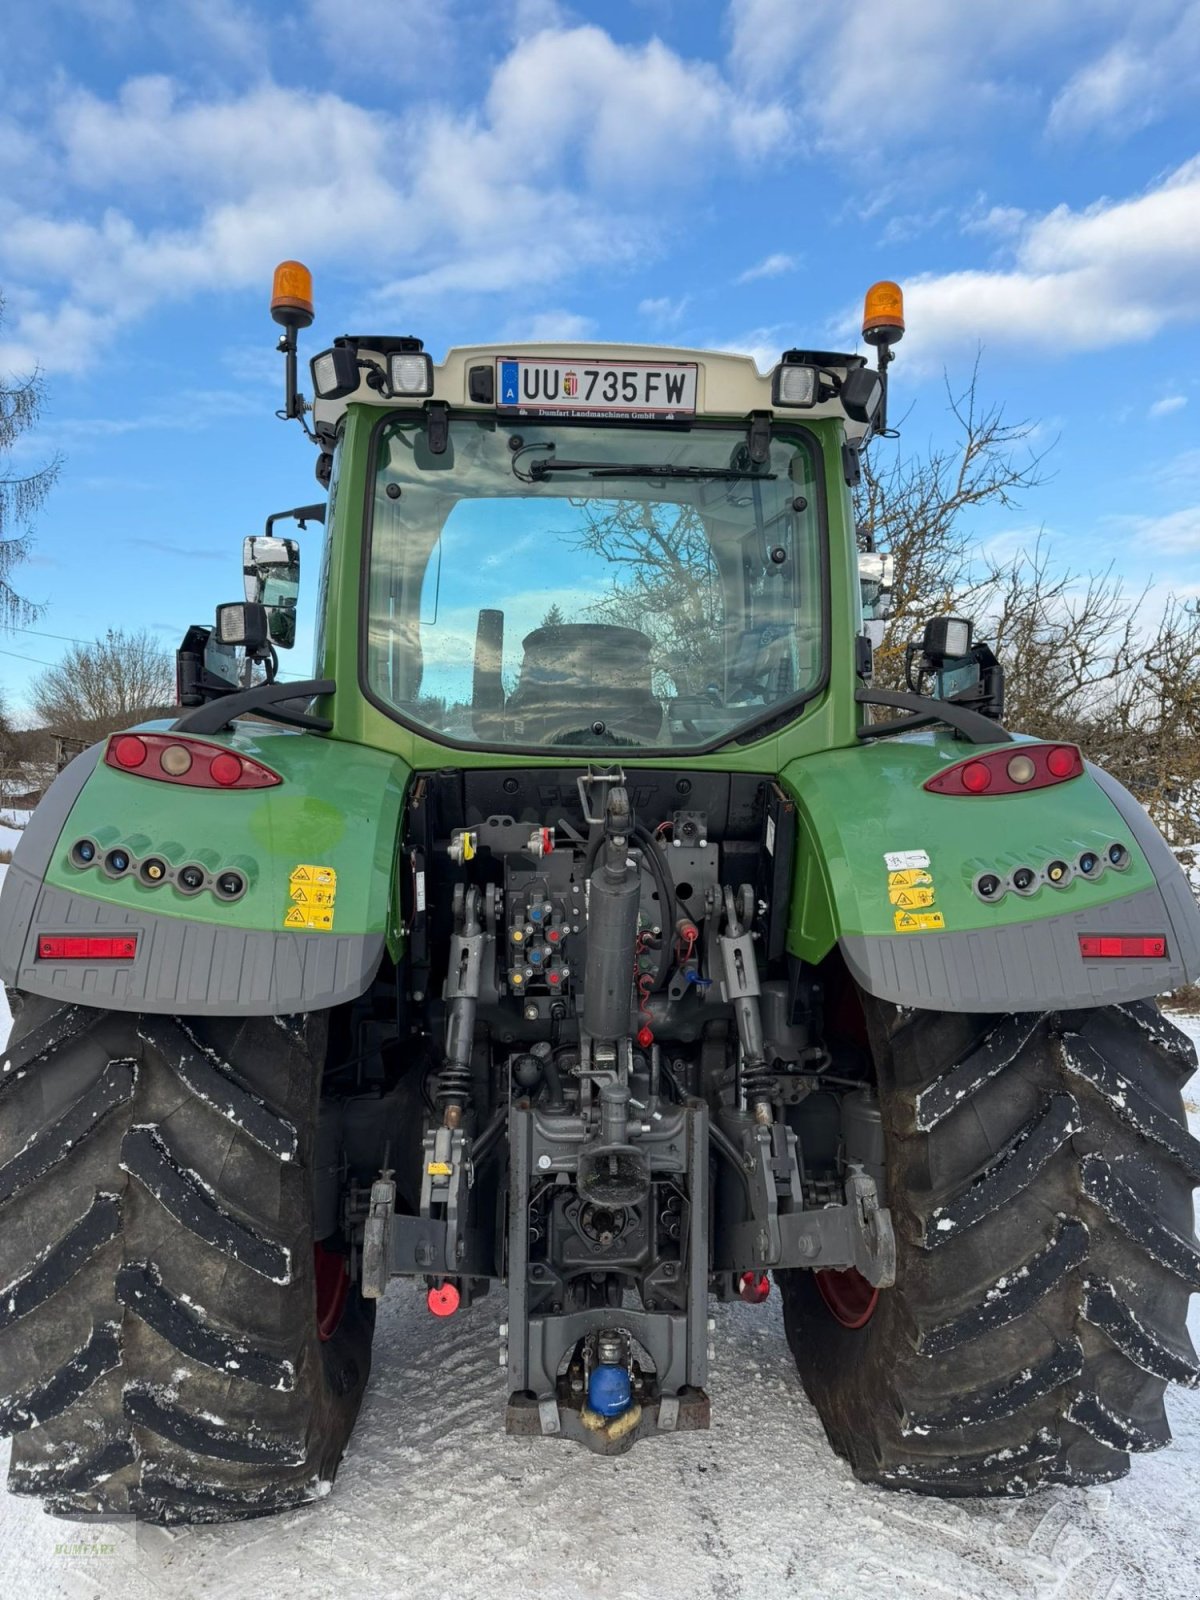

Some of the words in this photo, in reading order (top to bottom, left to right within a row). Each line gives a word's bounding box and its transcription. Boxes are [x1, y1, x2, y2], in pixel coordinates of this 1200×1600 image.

[523, 368, 559, 401] UU
[506, 388, 514, 398] A
[539, 409, 569, 417] Dumfart
[571, 409, 630, 419] Landmaschinen
[631, 411, 655, 420] GmbH
